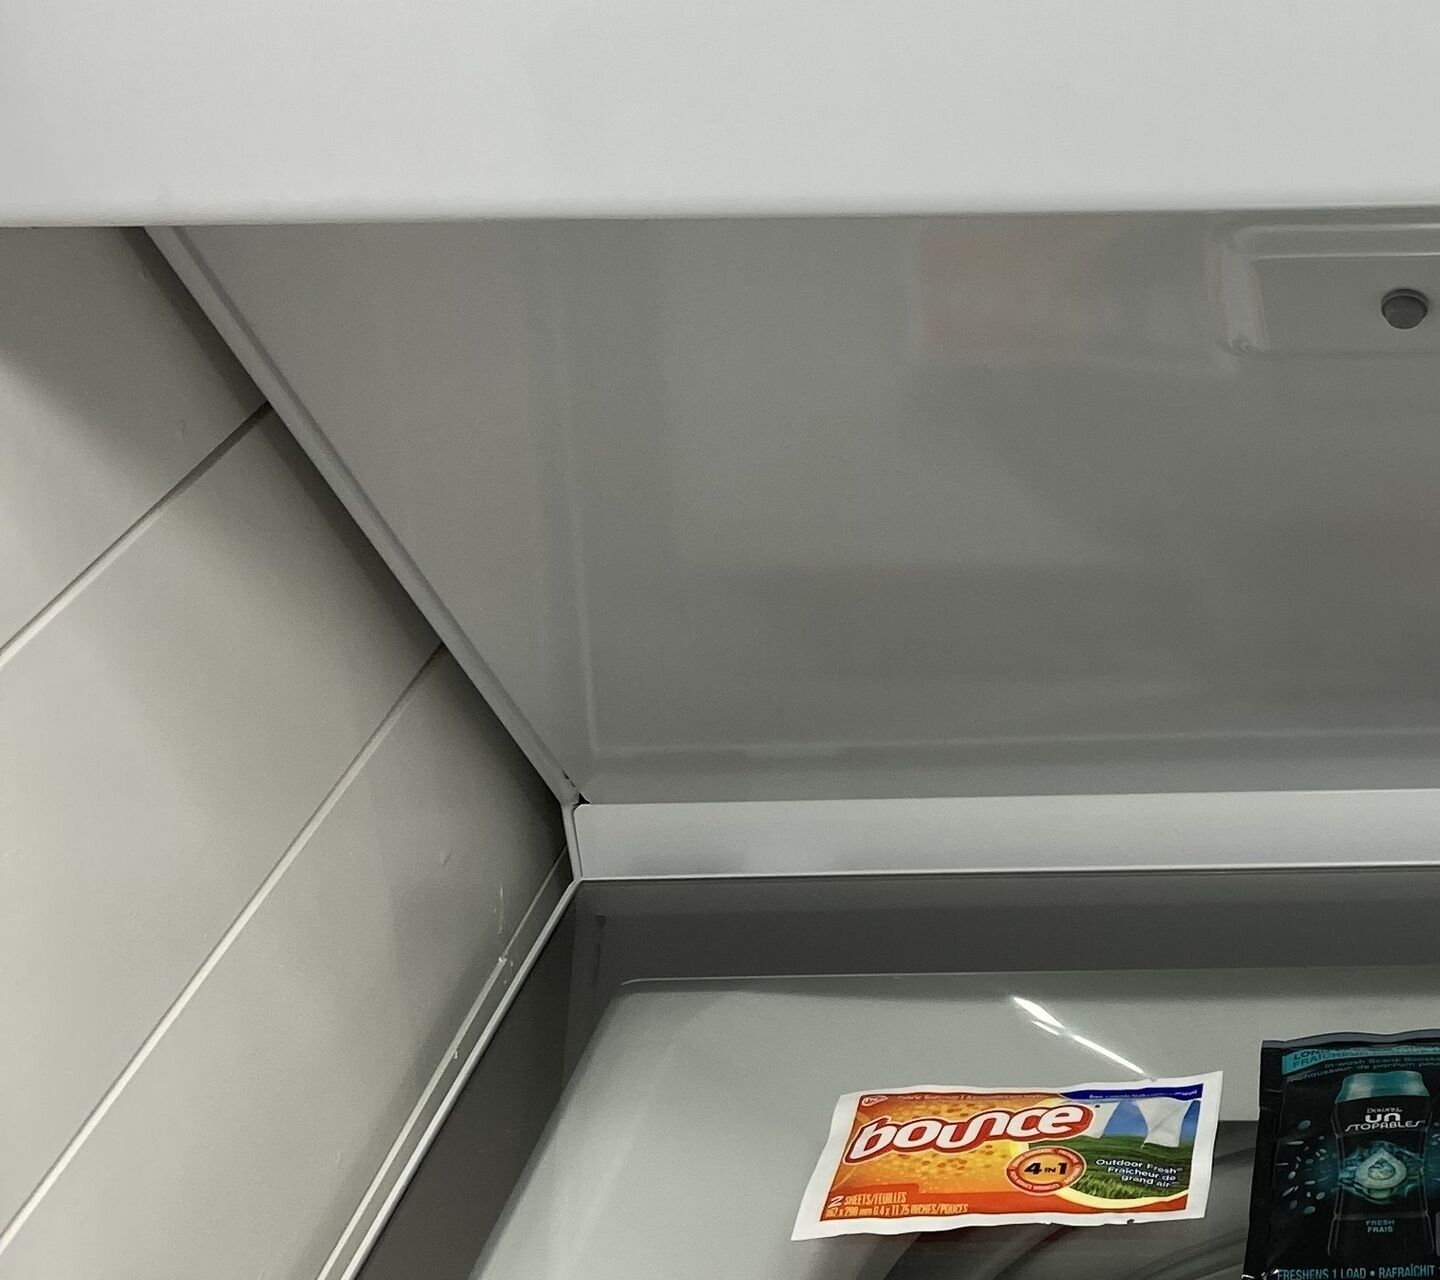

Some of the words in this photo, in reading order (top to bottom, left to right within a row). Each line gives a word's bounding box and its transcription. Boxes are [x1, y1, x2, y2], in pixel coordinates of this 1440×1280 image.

[847, 1104, 1089, 1162] bounce
[1024, 1162, 1043, 1175] 4
[1058, 1162, 1068, 1175] 1
[1095, 1158, 1144, 1169] Outdoor
[1121, 1175, 1154, 1186] grand
[1161, 1172, 1177, 1181] de
[827, 1196, 845, 1209] 2
[844, 1192, 907, 1207] SHEETS/FEUILLES
[910, 1203, 969, 1215] INCHES/POUCES
[1367, 1226, 1394, 1234] FRAIS
[1277, 1268, 1329, 1280] FRESHENS
[1332, 1268, 1338, 1279] 1
[1340, 1267, 1367, 1279] LOAD
[1378, 1263, 1435, 1279] RAFRAÎCHIT
